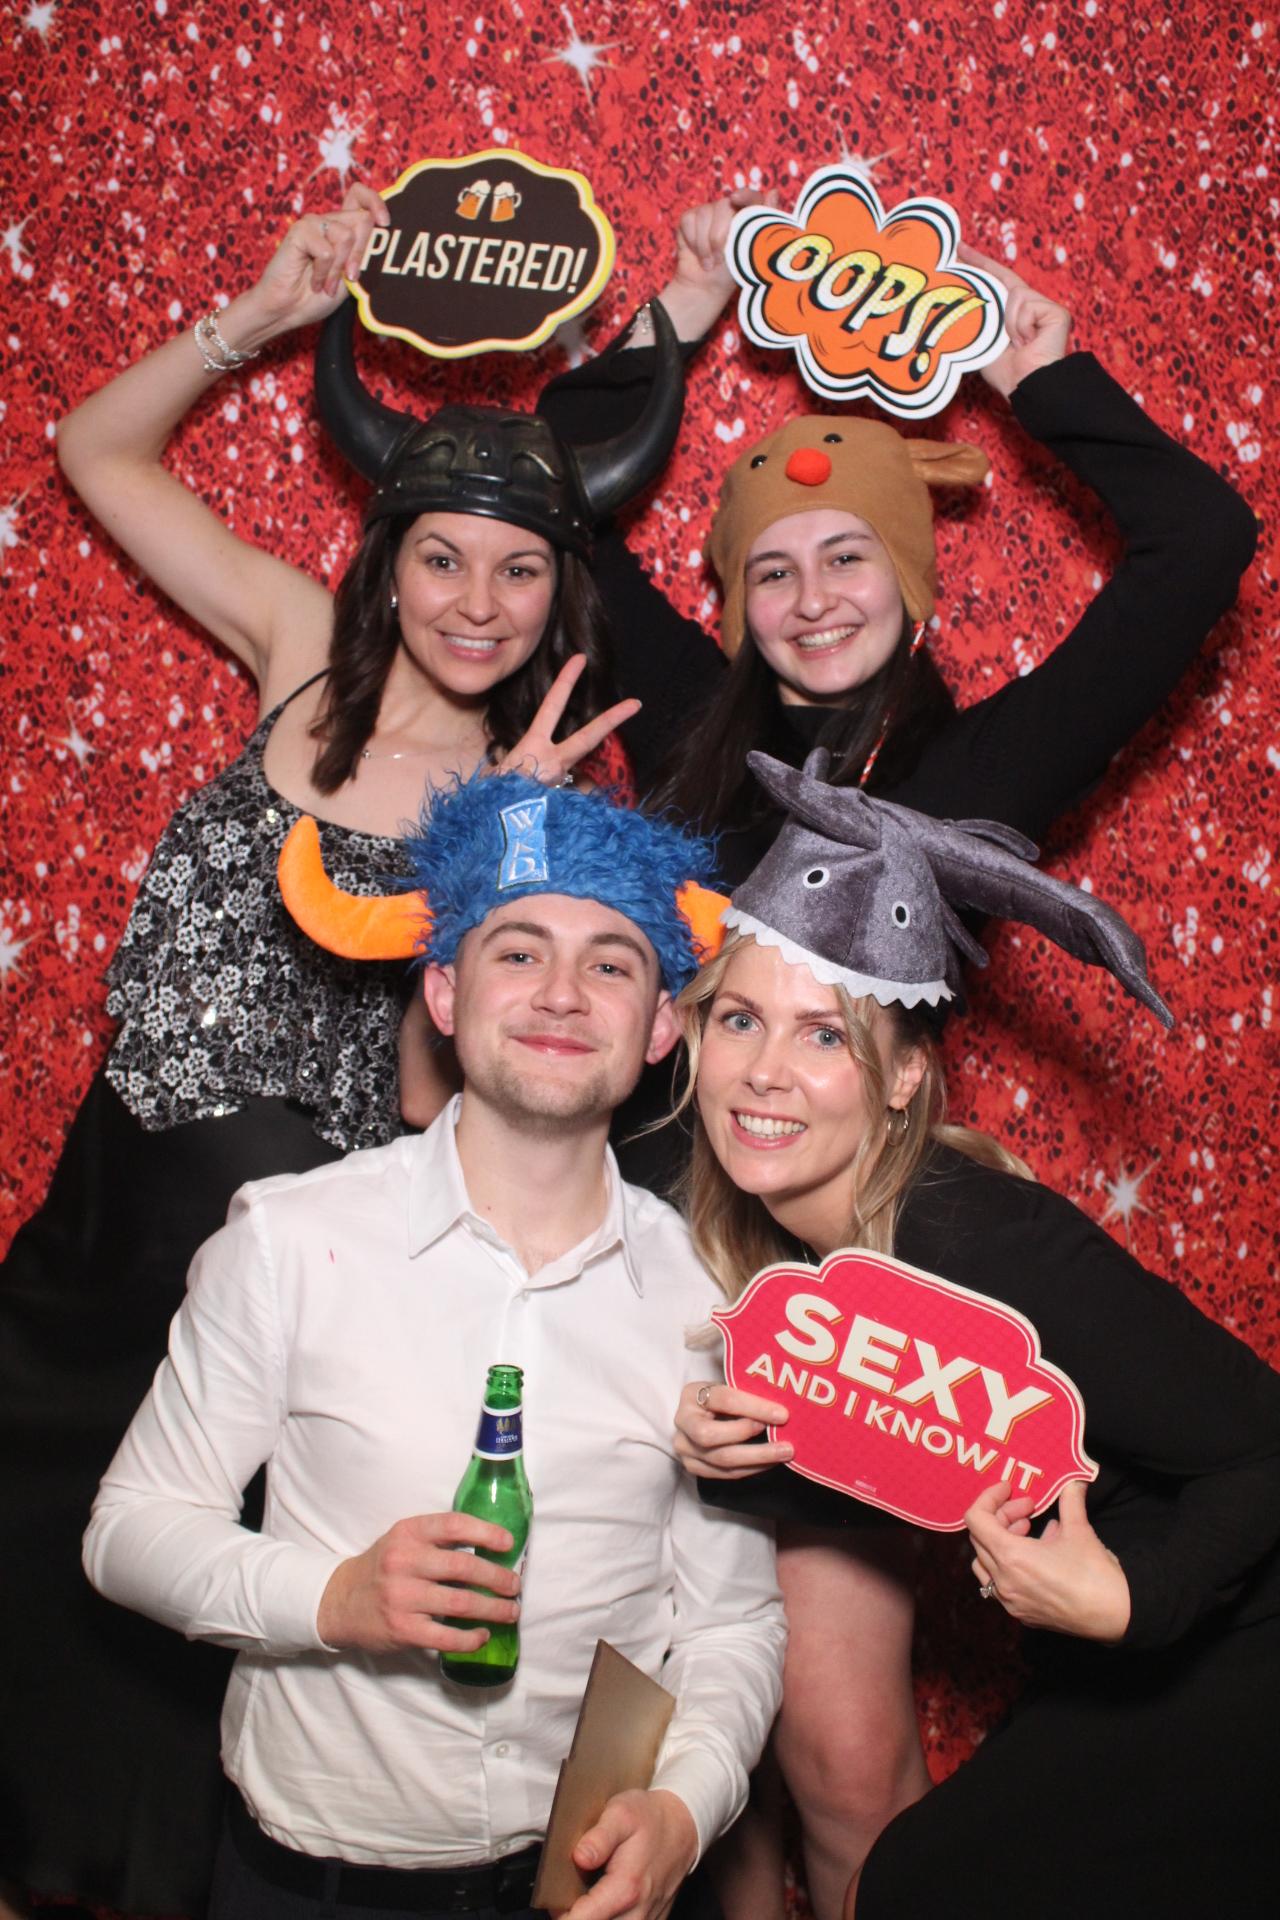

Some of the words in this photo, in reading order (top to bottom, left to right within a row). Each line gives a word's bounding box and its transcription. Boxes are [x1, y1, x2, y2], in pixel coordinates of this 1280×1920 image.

[360, 227, 588, 294] PLASTERED!
[768, 233, 992, 382] OOPS!
[745, 1352, 839, 1407] AND
[842, 1390, 861, 1417] I
[863, 1398, 998, 1474] KNOW
[1000, 1456, 1045, 1491] IT
[774, 1292, 1056, 1445] SEXY
